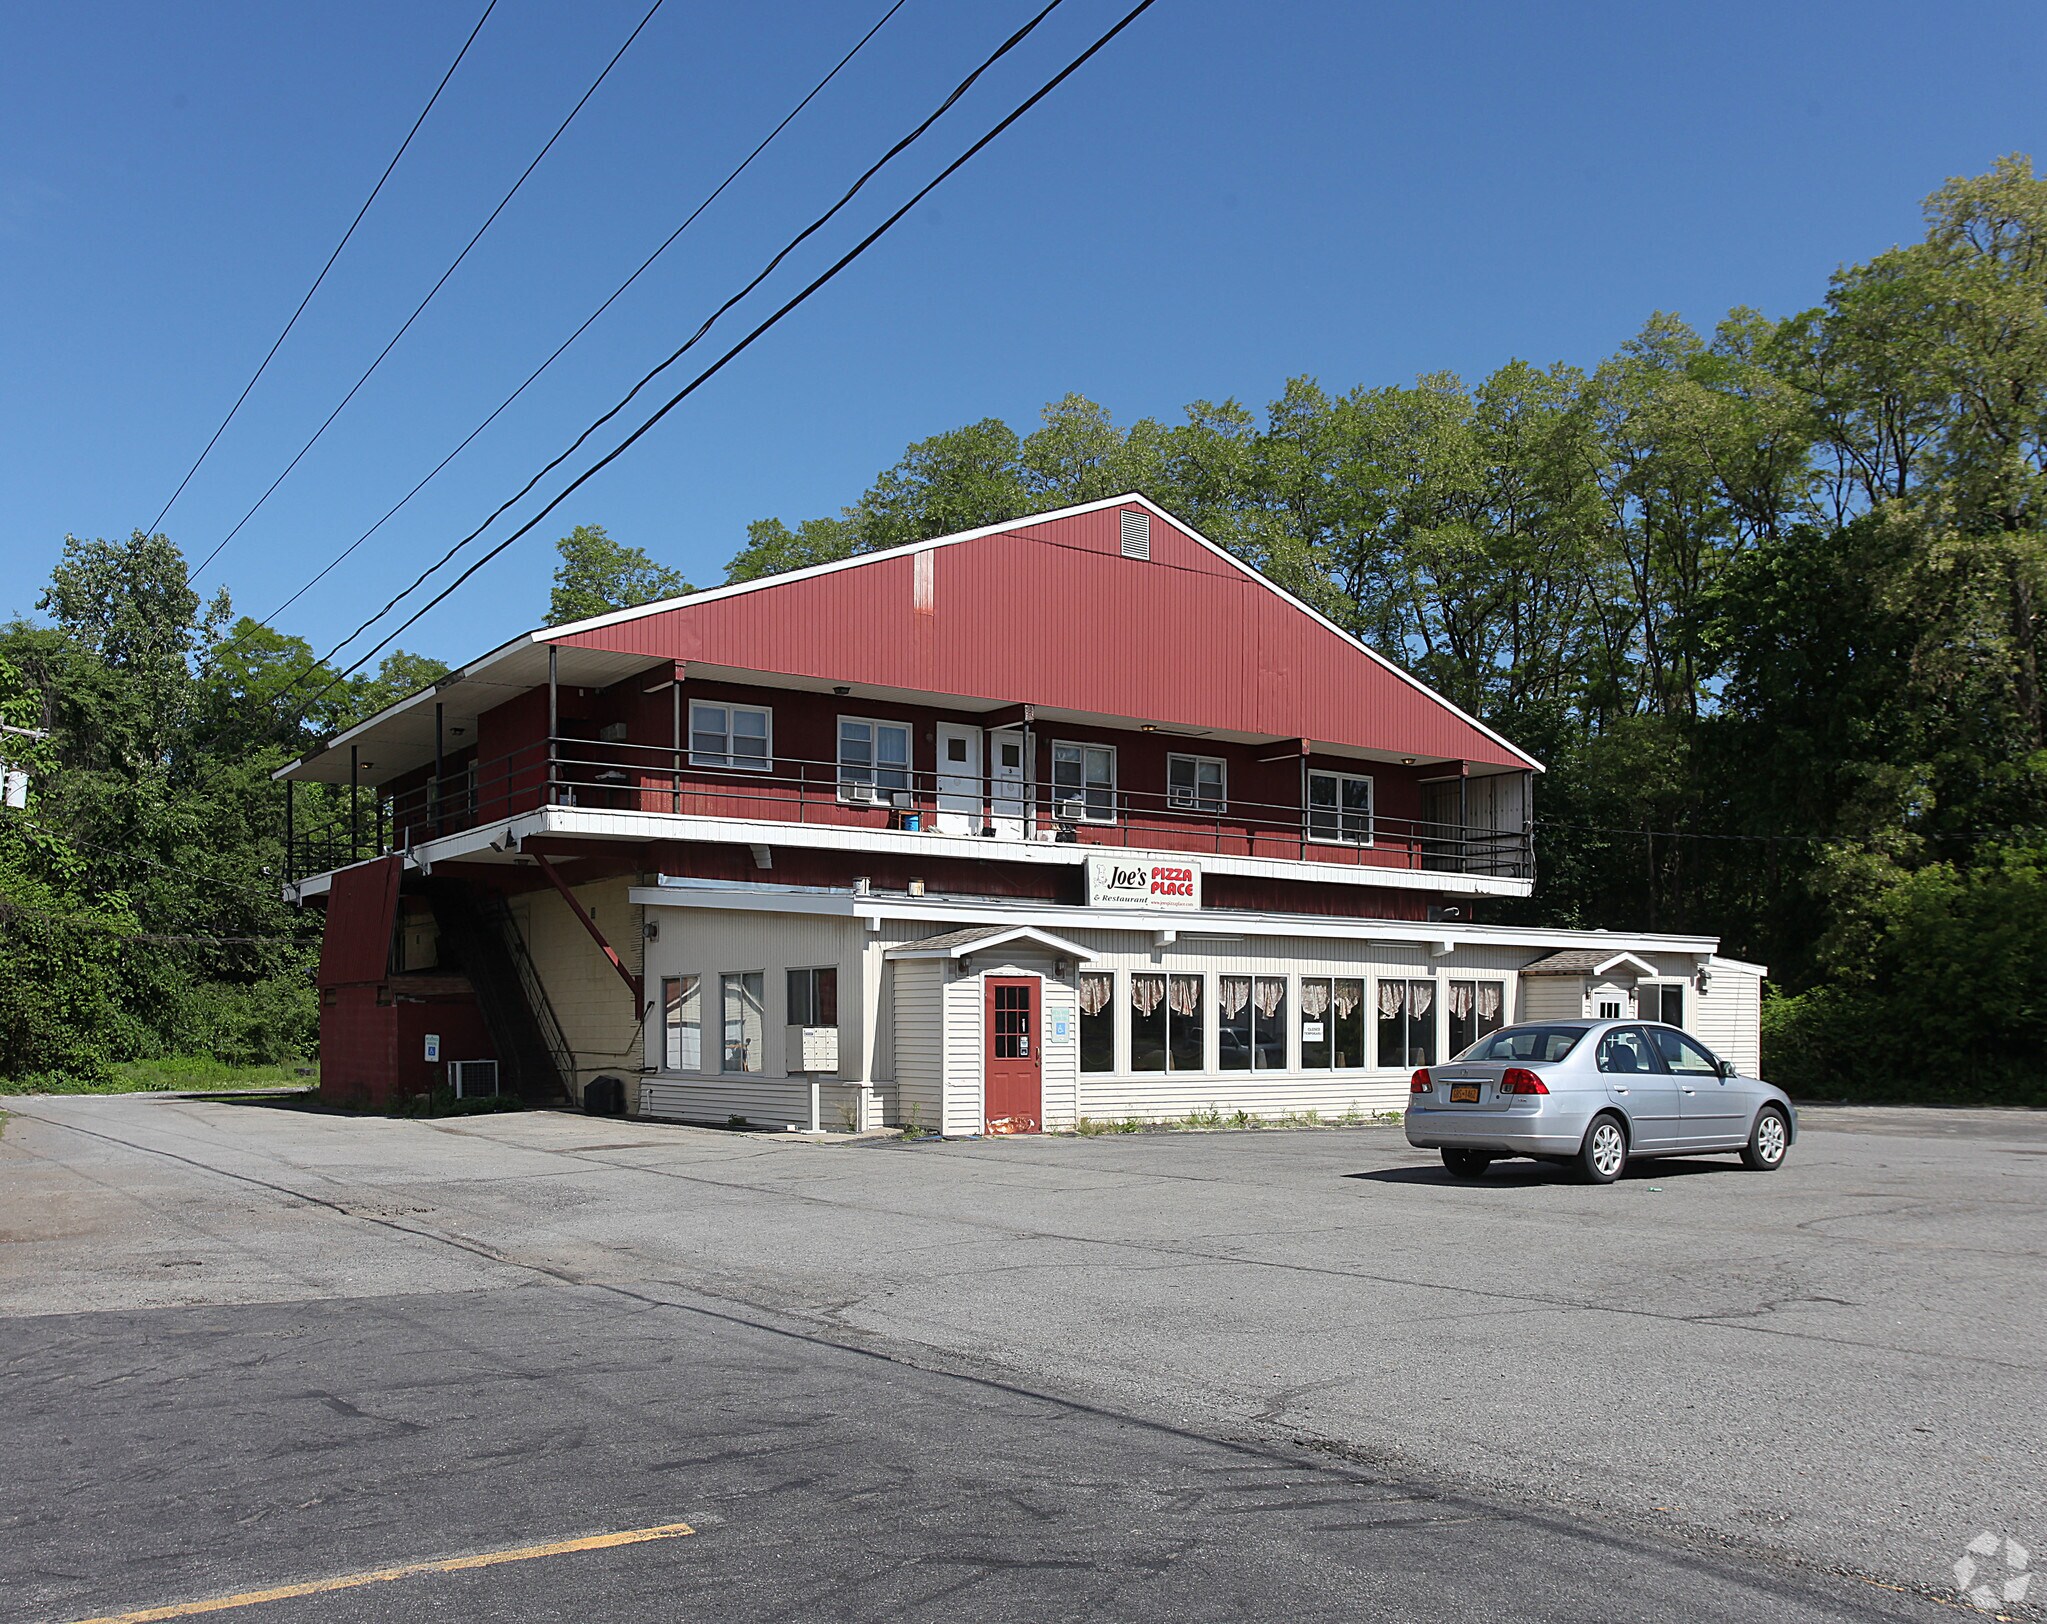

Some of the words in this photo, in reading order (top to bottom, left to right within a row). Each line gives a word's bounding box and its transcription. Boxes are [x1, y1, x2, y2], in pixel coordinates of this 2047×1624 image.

[1107, 866, 1147, 889] Joe's
[1151, 867, 1192, 881] PIZZA
[1151, 882, 1194, 896] PLACE
[1102, 894, 1148, 904] Restaurant
